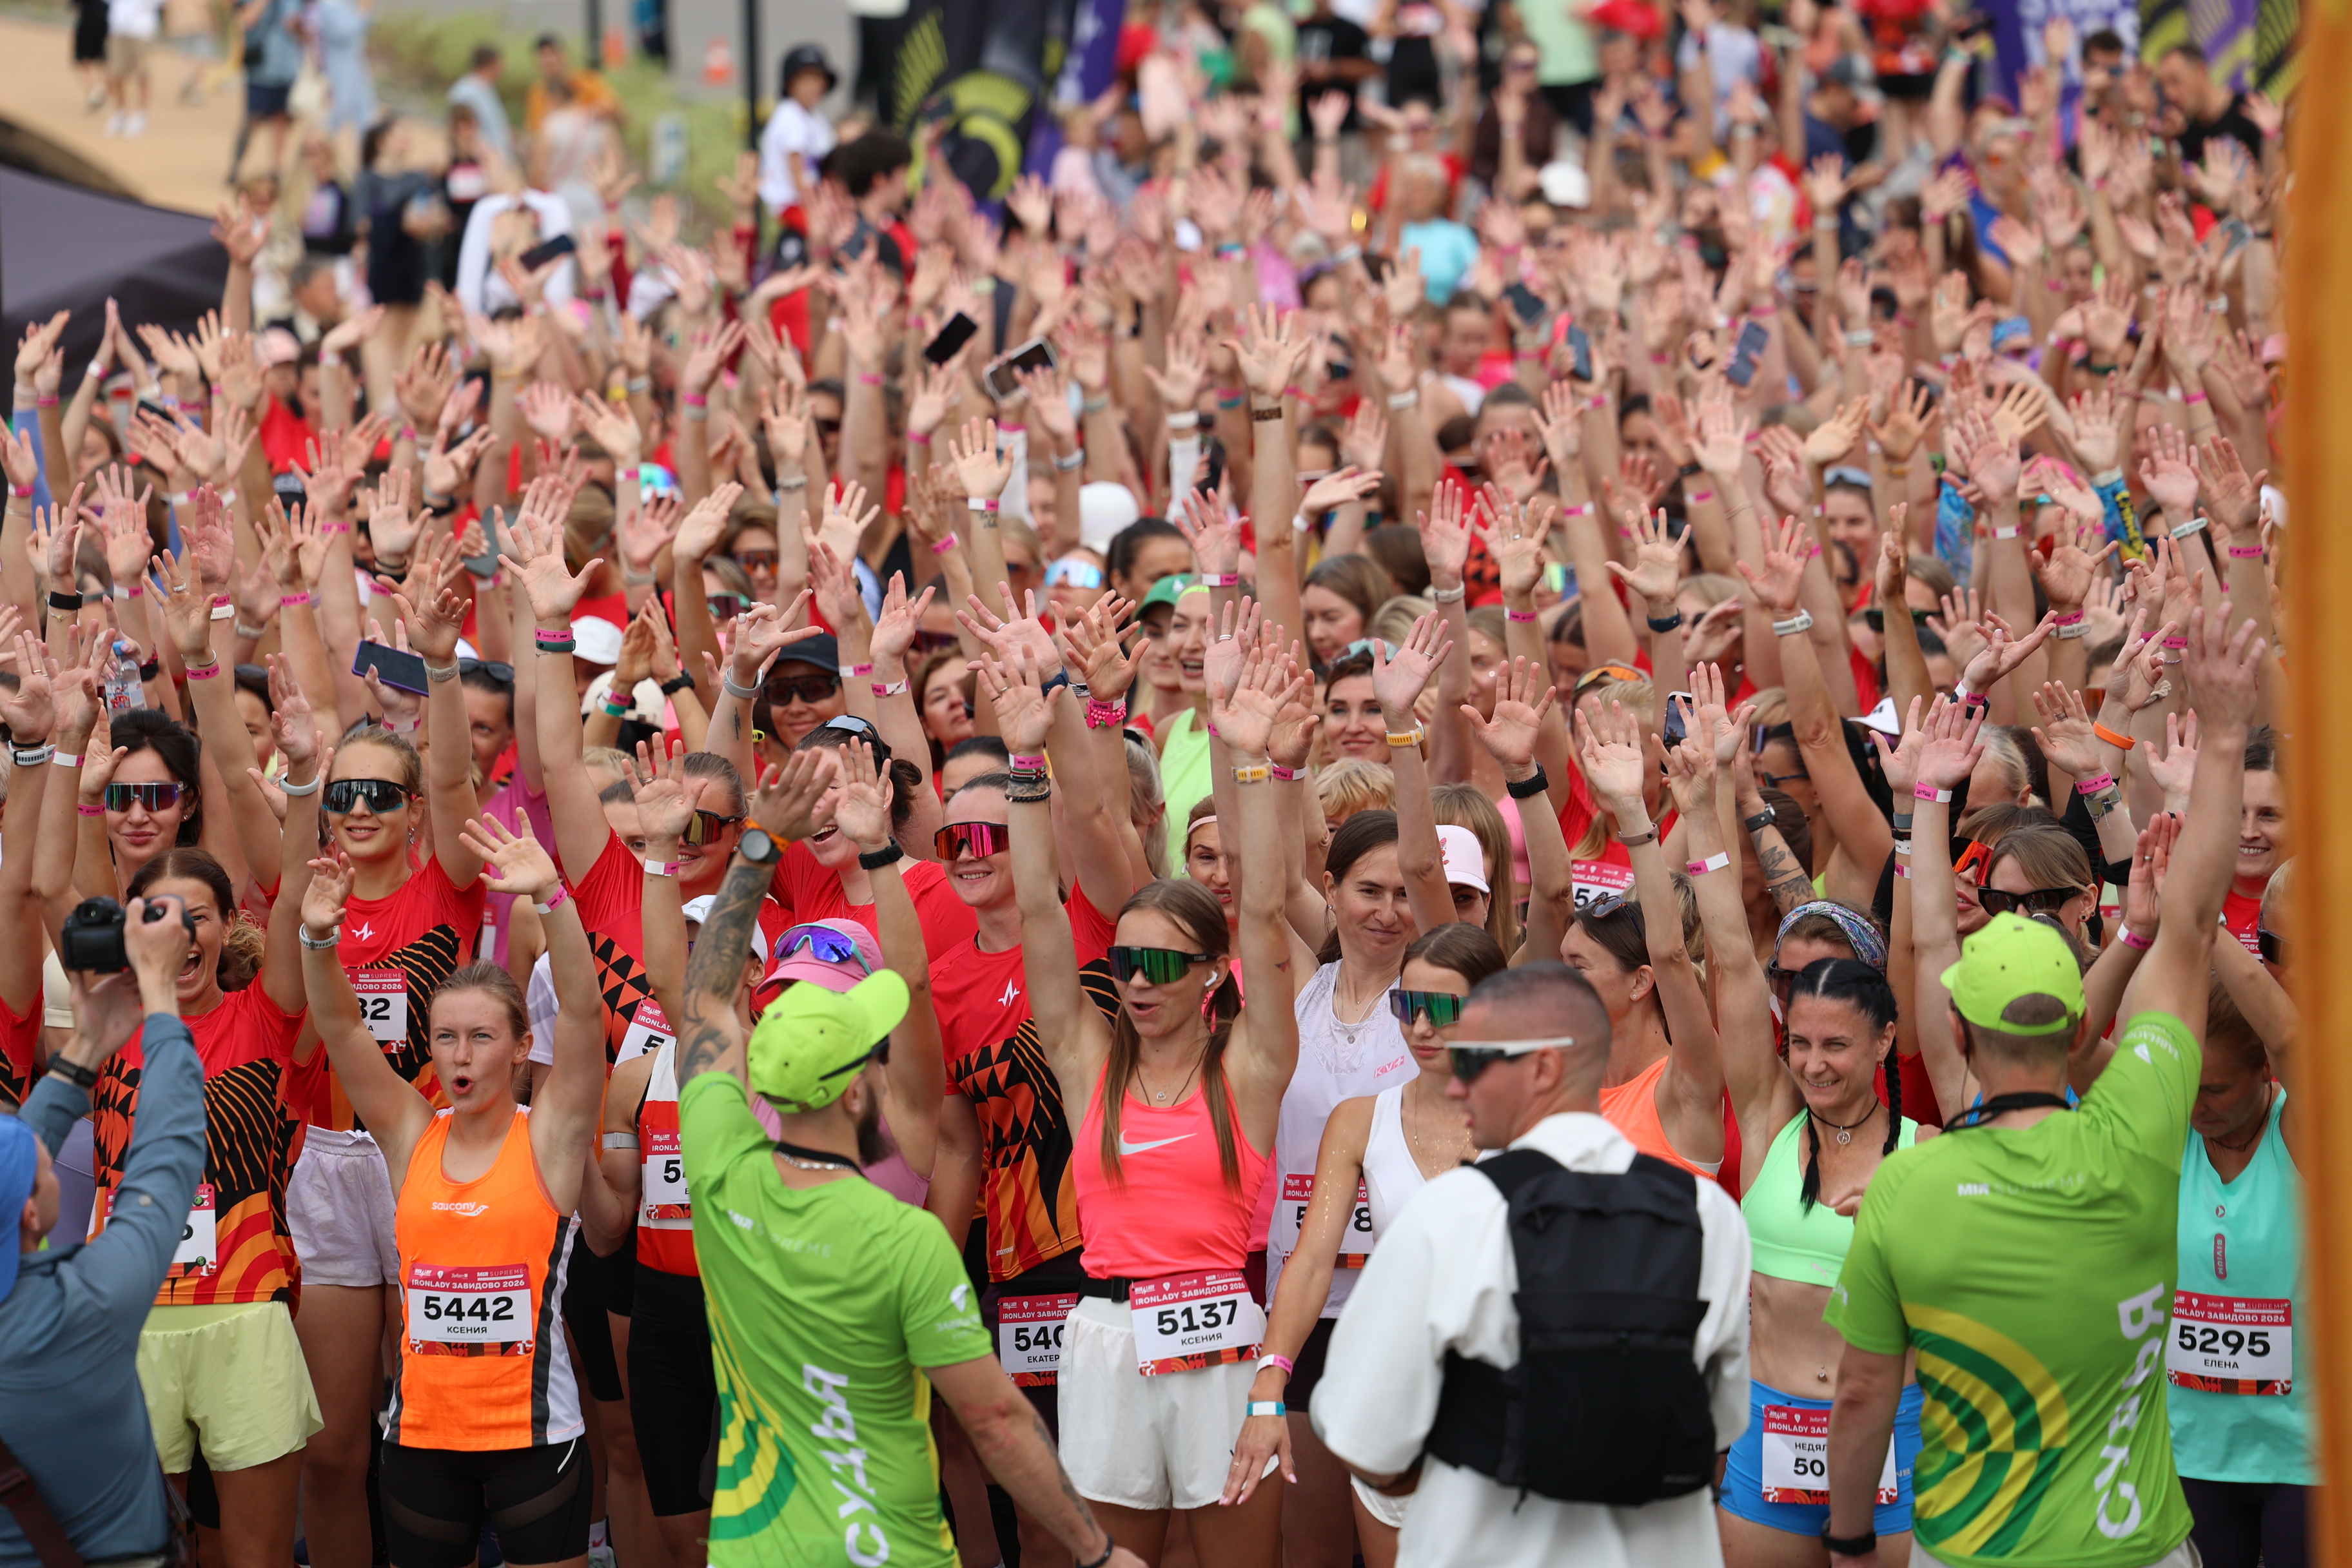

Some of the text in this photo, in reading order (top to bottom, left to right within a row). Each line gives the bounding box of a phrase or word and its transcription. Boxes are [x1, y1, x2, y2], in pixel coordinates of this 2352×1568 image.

[638, 1015, 672, 1031] IRONLAD
[431, 1201, 476, 1211] saucony
[489, 1268, 524, 1277] SUPREME
[412, 1279, 450, 1288] IRONLADY
[452, 1280, 500, 1290] ЗАВИДОВО
[1135, 1282, 1245, 1306] IRONLADY ЗАВИДОВО 2026
[424, 1296, 514, 1321] 5442
[2173, 1307, 2205, 1318] ONLADY
[2208, 1313, 2258, 1322] ЗАВИДОВО
[1003, 1311, 1035, 1320] IRONLADY
[1157, 1299, 1237, 1336] 5137
[1181, 1333, 1222, 1346] КСЕНИЯ
[2179, 1324, 2271, 1358] 5295
[1027, 1355, 1060, 1363] ЕКАТЕР
[2204, 1358, 2239, 1369] ЕЛЕНА
[1769, 1422, 1808, 1433] IRONLADY
[1794, 1442, 1827, 1453] НЕДЯЛ
[1793, 1458, 1825, 1477] 50
